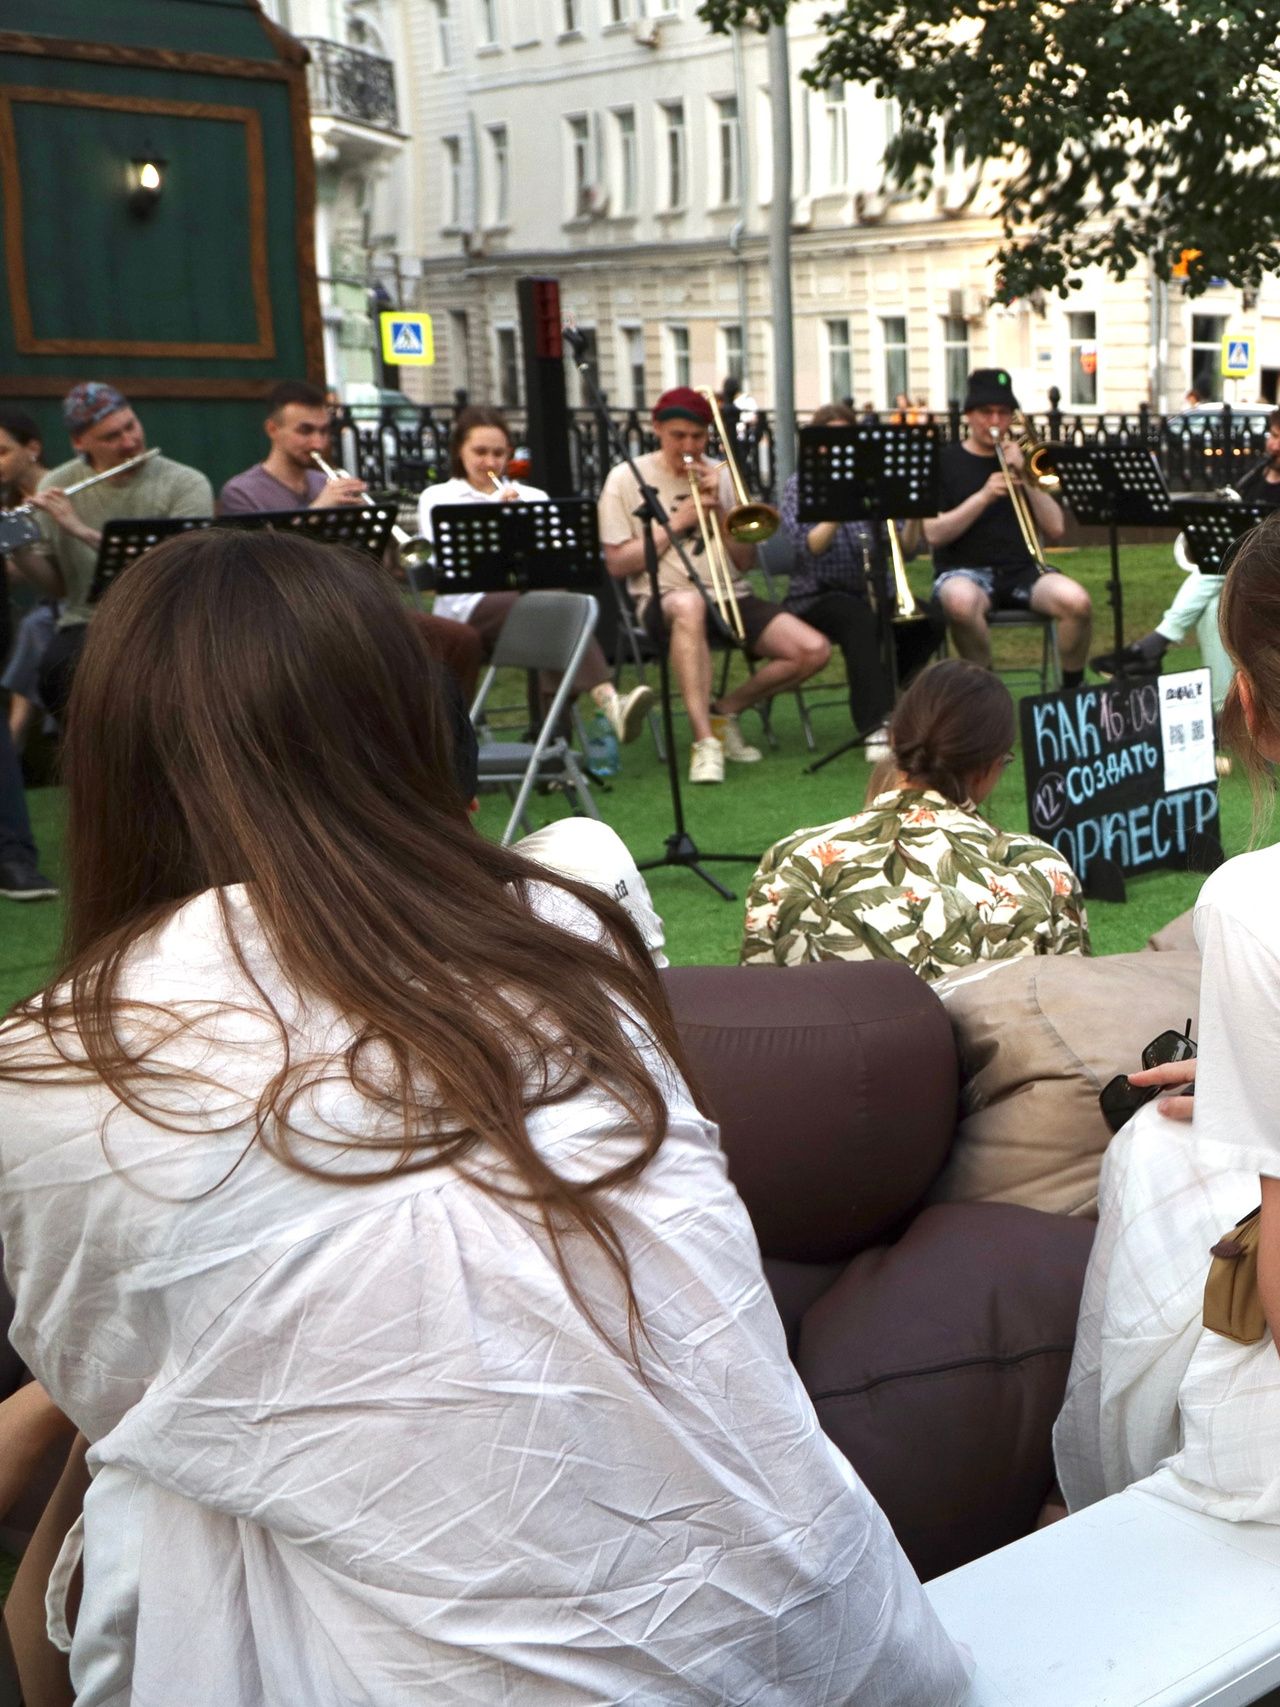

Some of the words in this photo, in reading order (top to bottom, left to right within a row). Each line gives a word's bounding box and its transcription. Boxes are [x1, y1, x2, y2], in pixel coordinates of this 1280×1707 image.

[1033, 692, 1101, 767] КАК
[1100, 685, 1159, 742] 16:00
[1066, 742, 1158, 804] СОЗДАТЬ
